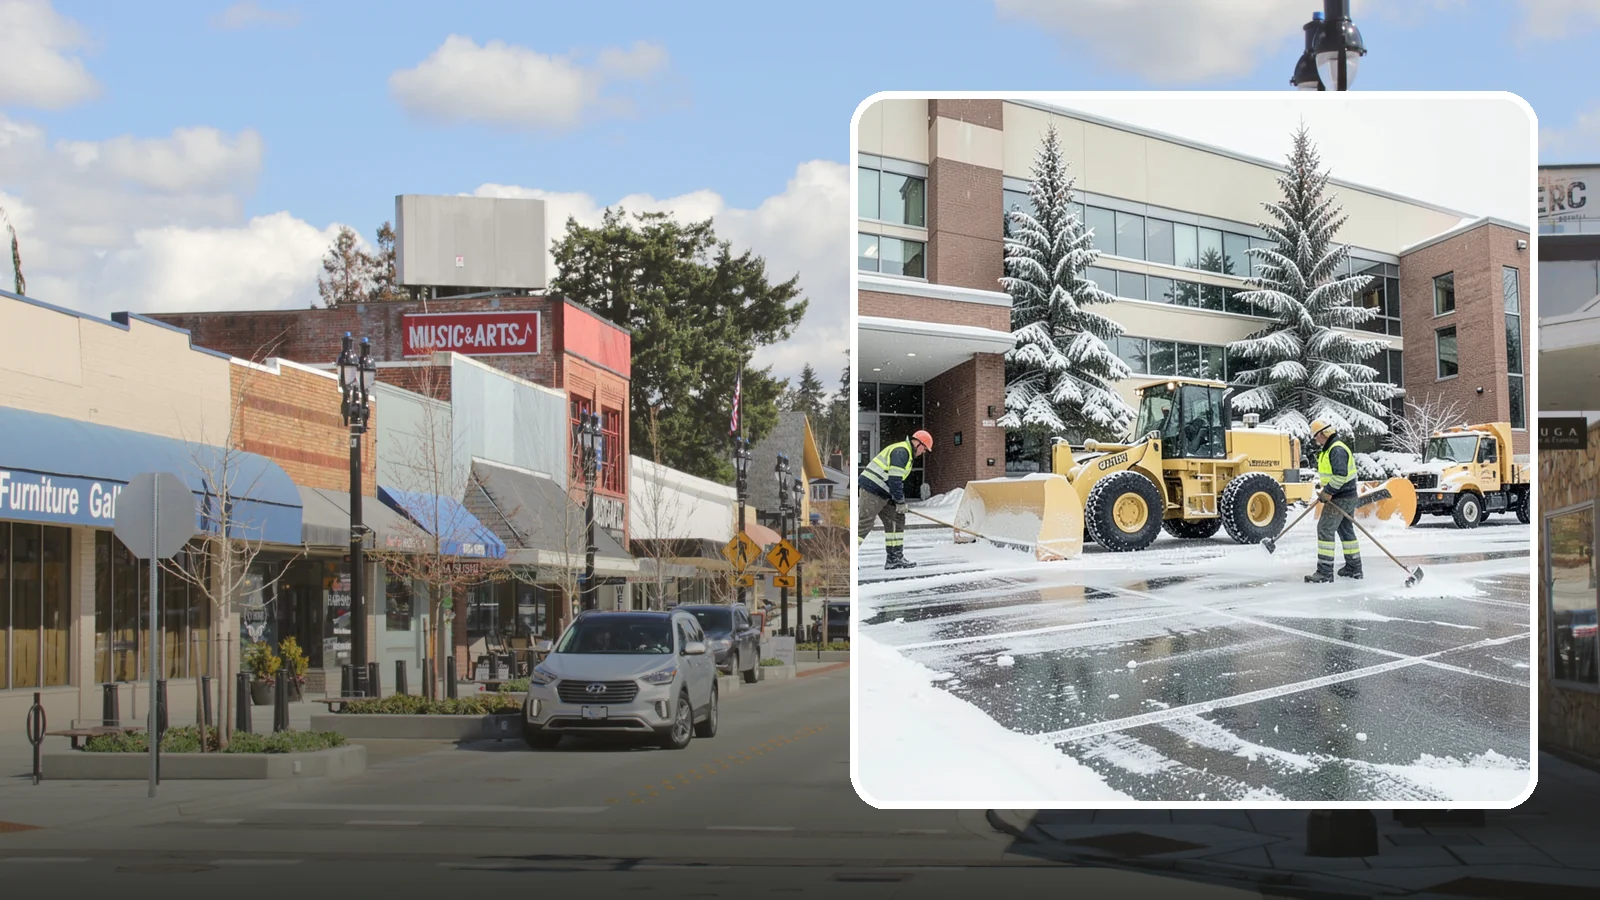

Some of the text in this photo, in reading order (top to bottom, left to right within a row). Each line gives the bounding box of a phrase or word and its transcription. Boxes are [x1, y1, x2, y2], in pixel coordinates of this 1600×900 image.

[1540, 427, 1577, 437] UGA
[0, 471, 79, 515] Furniture
[453, 563, 479, 574] SUSHI
